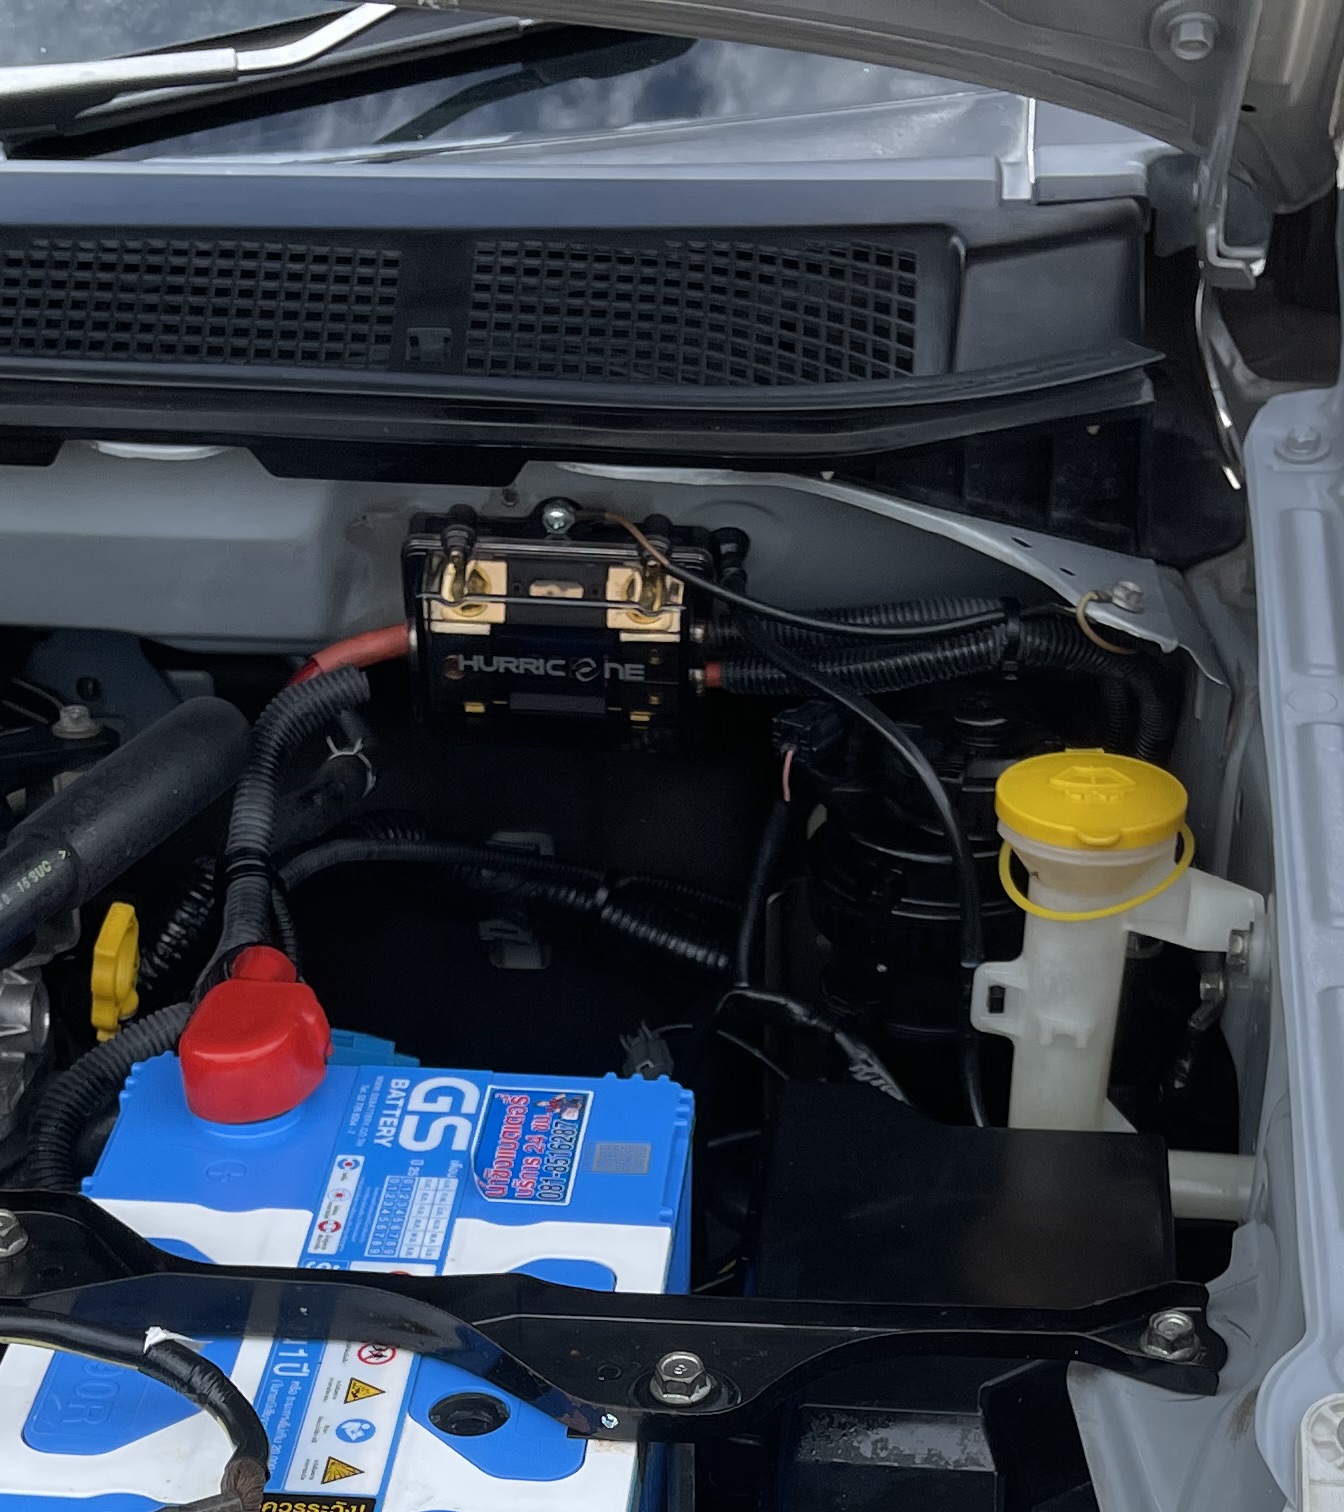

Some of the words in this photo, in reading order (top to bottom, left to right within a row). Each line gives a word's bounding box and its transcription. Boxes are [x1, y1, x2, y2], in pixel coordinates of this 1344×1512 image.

[373, 1078, 410, 1148] BATTERY
[398, 1077, 480, 1151] GS
[523, 1135, 546, 1154] 24
[512, 1157, 541, 1198] บริการ
[536, 1120, 578, 1200] 081-8516287
